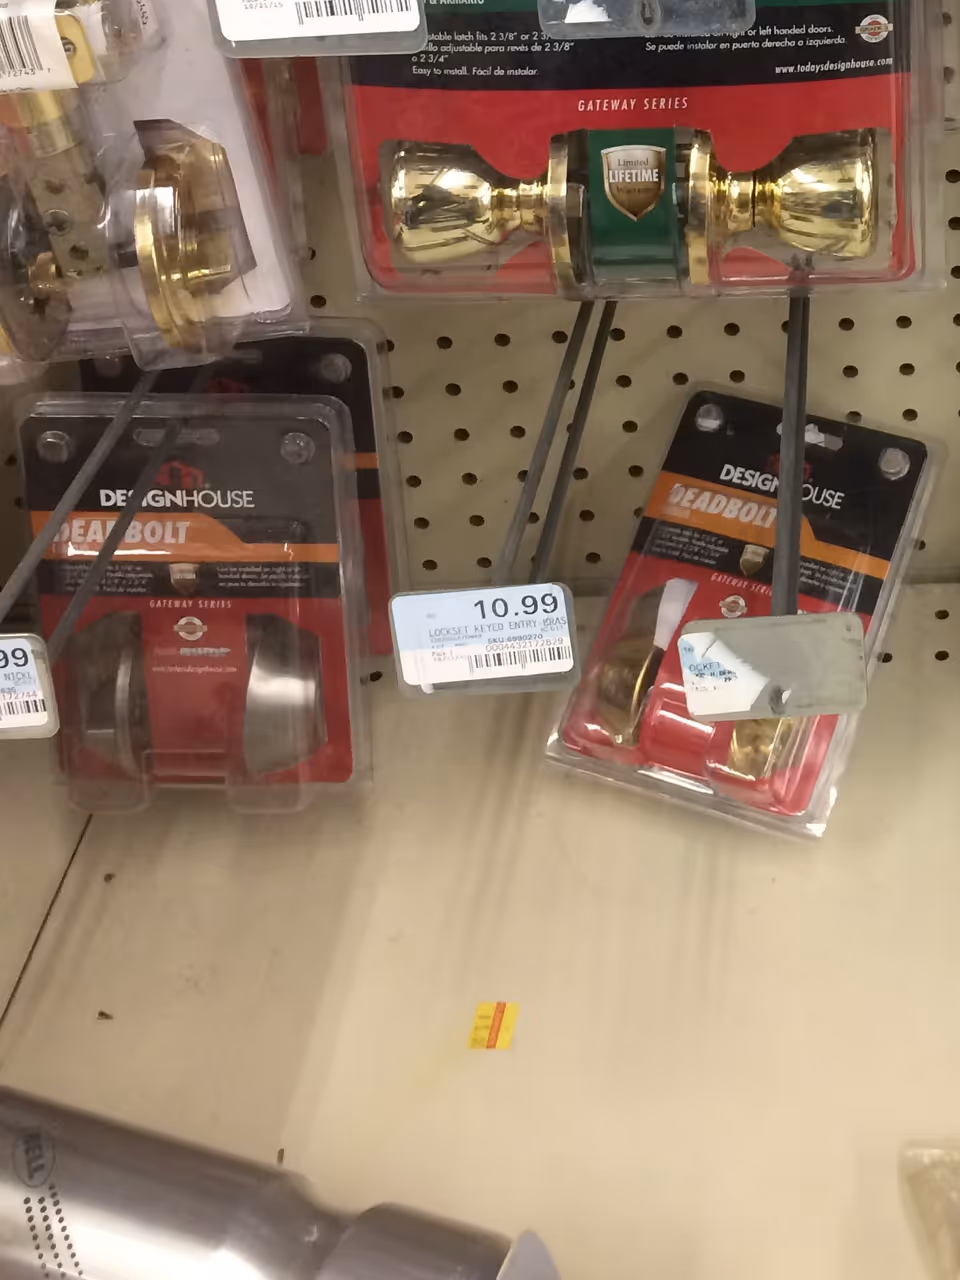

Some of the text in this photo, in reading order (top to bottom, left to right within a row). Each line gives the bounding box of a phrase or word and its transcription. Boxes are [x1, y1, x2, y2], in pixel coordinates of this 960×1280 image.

[454, 31, 475, 41] latch
[759, 26, 773, 36] left
[773, 24, 806, 35] handed
[440, 42, 529, 54] adjustable para revés
[658, 40, 685, 52] puede
[686, 39, 718, 50] instalar
[732, 40, 760, 51] puerta
[761, 38, 796, 48] derecha
[412, 65, 431, 77] Easy
[472, 65, 492, 76] Fácil
[775, 56, 893, 74] www.todaysdesignhouse.com
[578, 97, 688, 112] GATEWAY SERIES
[617, 157, 649, 167] Limited
[608, 168, 659, 184] LIFETIME
[149, 599, 194, 609] GATEWAY
[473, 592, 559, 620] 10.99
[428, 626, 470, 638] LOCKSET
[474, 623, 504, 634] KEYED
[23, 1131, 46, 1181] BELL
